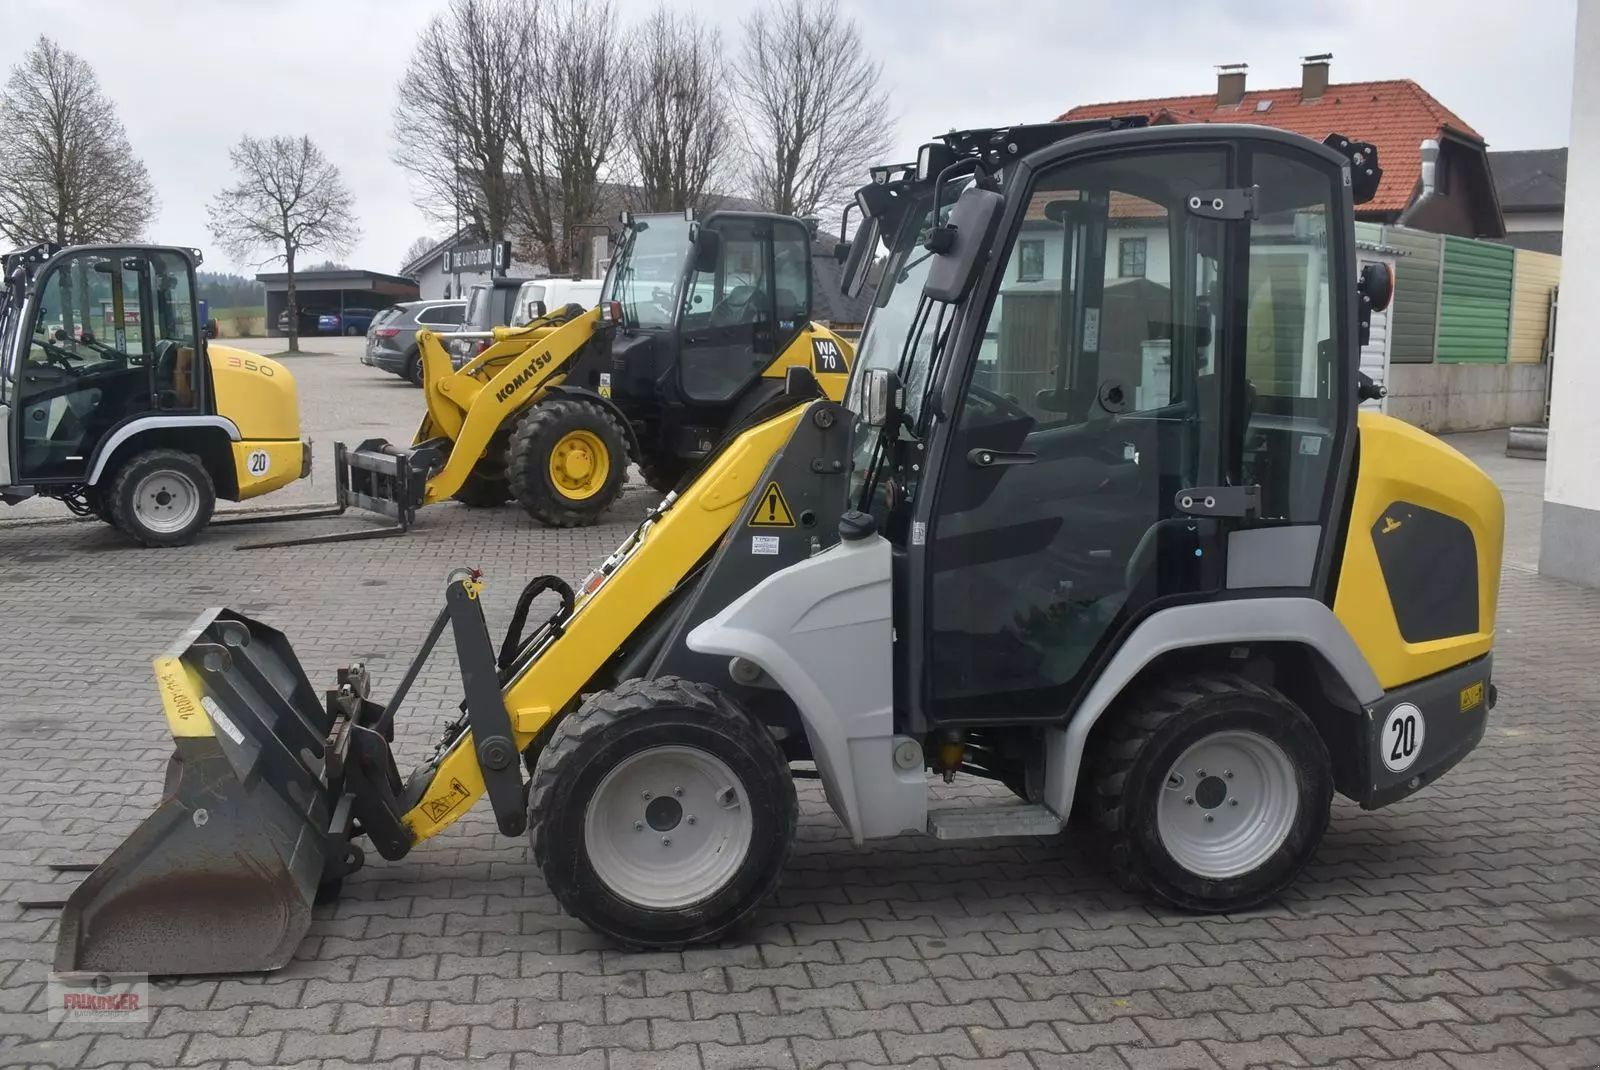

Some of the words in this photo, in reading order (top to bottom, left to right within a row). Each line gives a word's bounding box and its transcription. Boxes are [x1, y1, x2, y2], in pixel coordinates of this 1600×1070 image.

[815, 341, 838, 356] WA
[227, 357, 274, 377] 350
[822, 355, 836, 369] 70
[495, 350, 552, 403] KOMATSU
[251, 453, 267, 472] 20
[1390, 714, 1416, 761] 20
